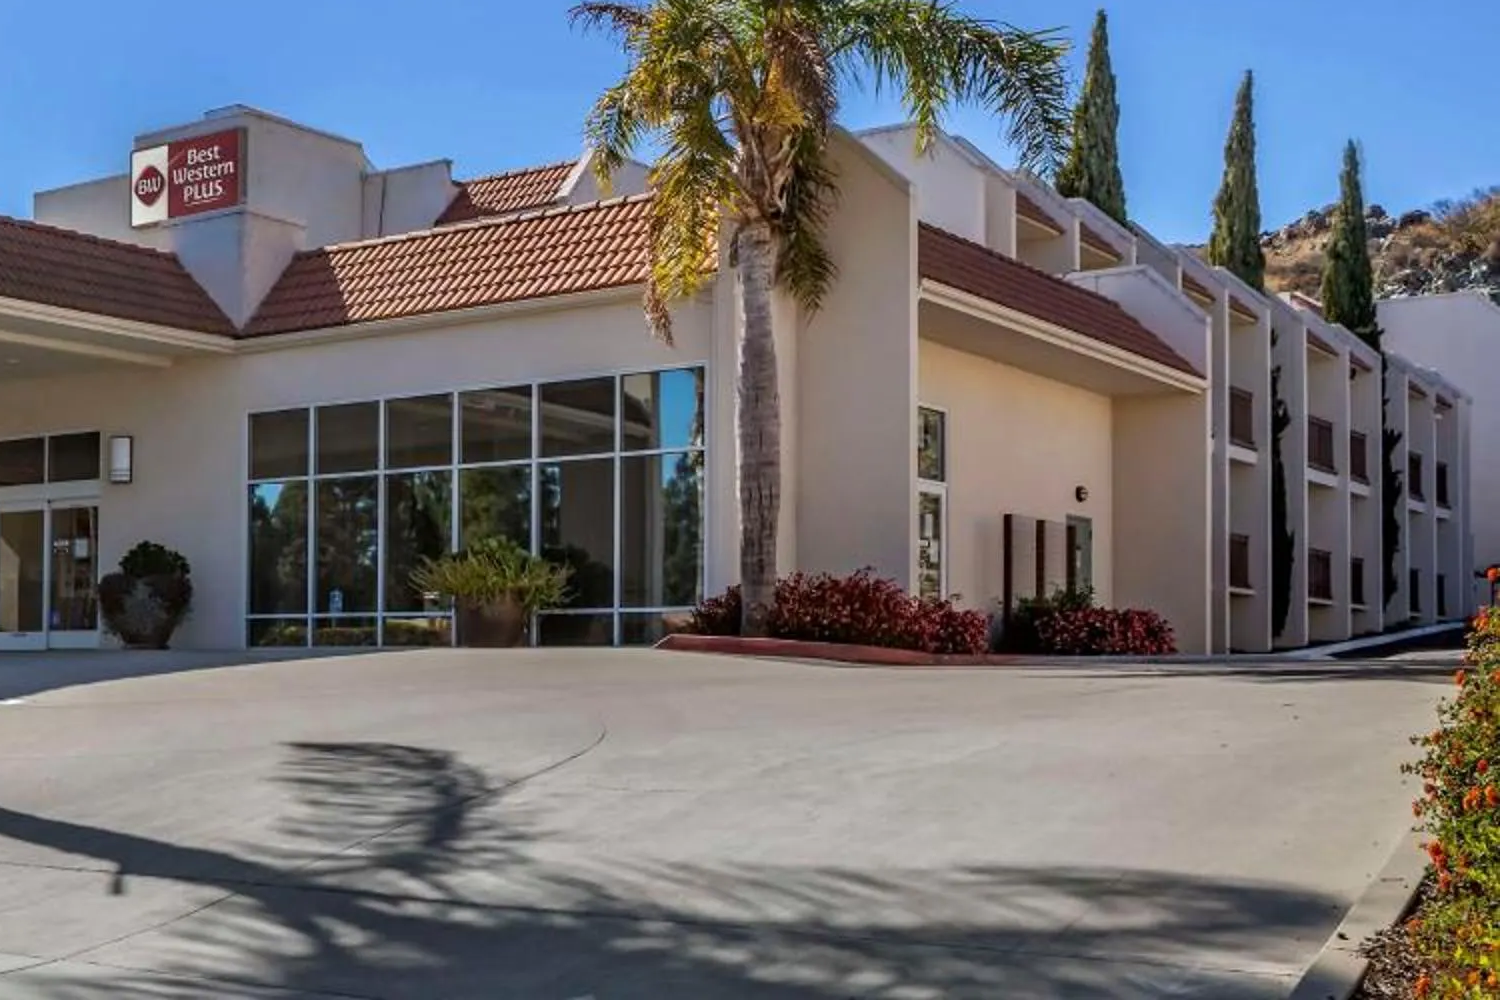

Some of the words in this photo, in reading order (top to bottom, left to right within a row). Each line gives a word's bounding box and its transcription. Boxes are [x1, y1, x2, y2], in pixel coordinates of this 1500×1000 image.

[187, 145, 220, 165] Best
[173, 161, 235, 185] Western
[137, 176, 161, 195] BW
[183, 180, 223, 201] PLUS
